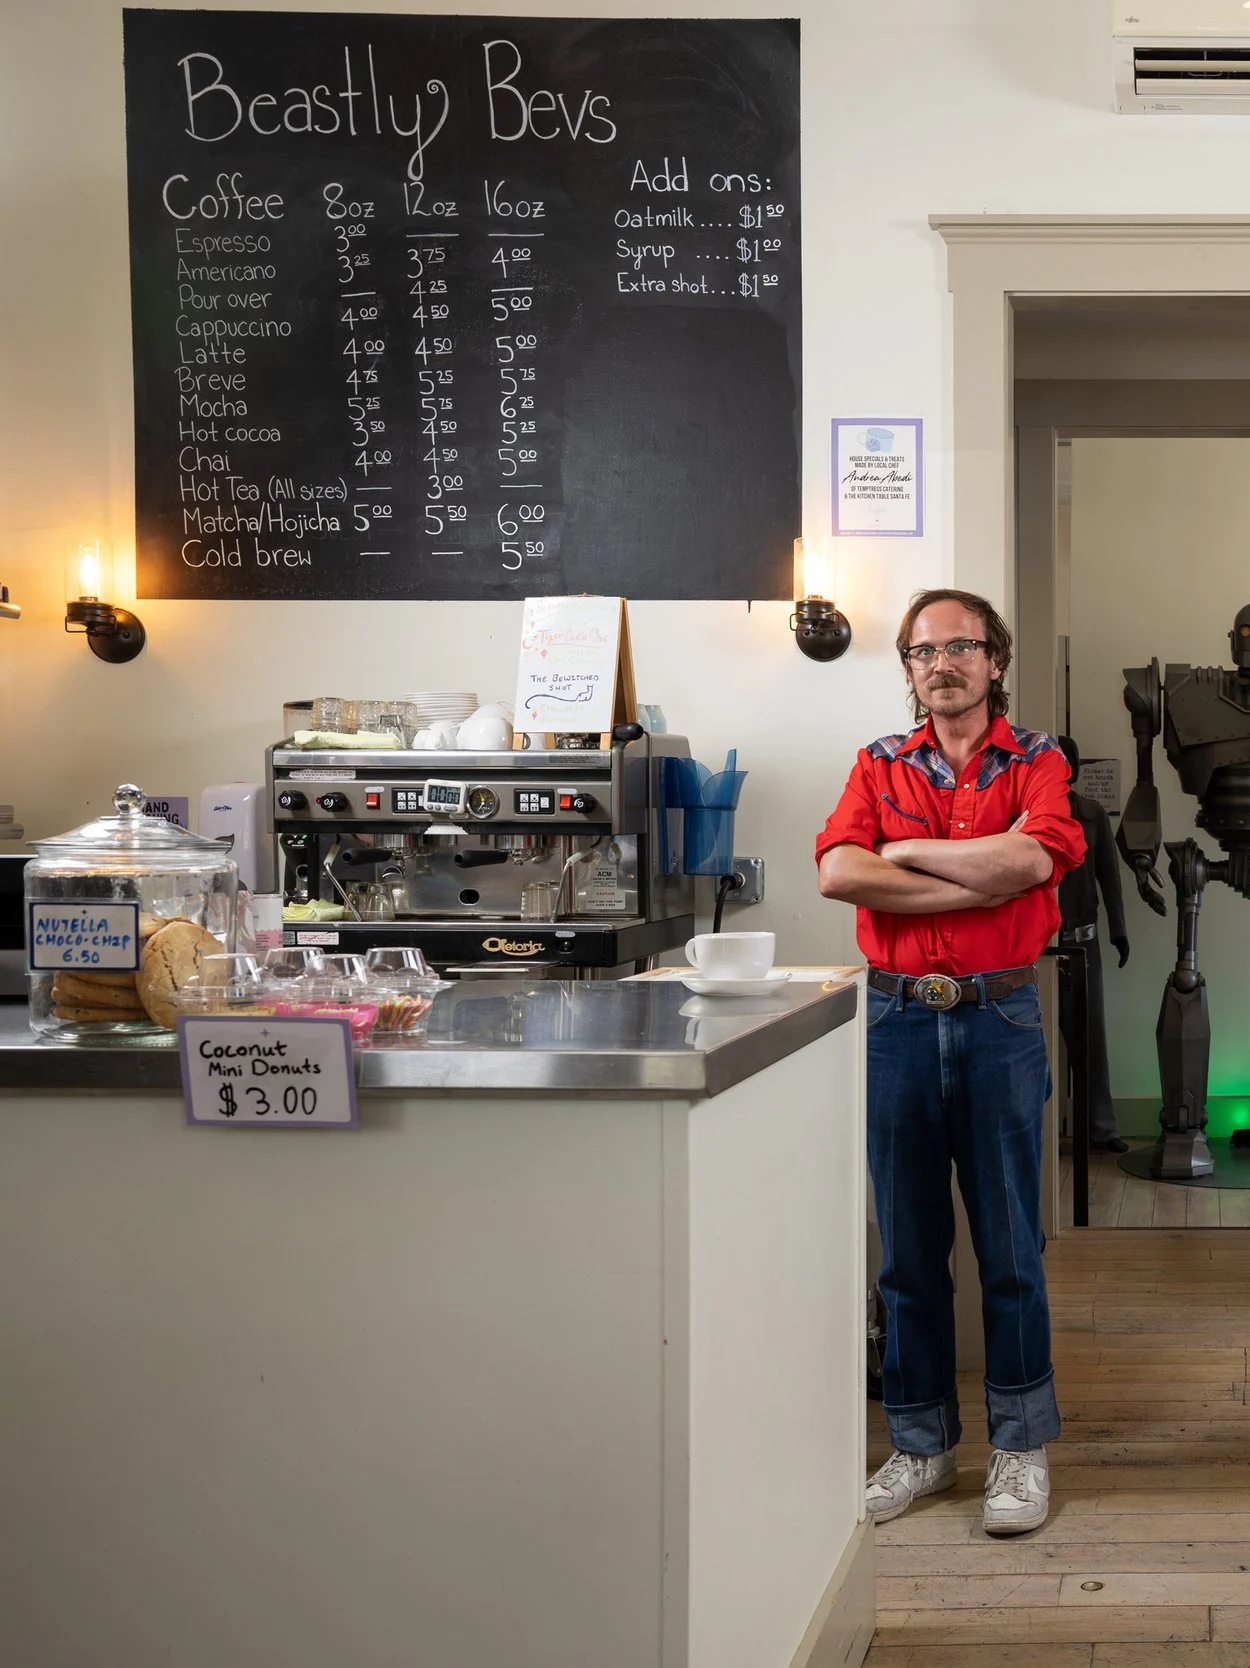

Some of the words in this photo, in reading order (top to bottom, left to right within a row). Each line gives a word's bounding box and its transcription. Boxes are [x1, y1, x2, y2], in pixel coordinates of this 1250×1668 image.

[178, 43, 449, 181] Beastly
[483, 40, 617, 143] Bevs
[630, 156, 689, 192] Add
[709, 172, 772, 193] ons:
[163, 172, 285, 220] Coffee
[323, 182, 375, 219] 8oz
[404, 181, 460, 217] 12oz
[484, 180, 546, 218] 16oz
[175, 228, 271, 260] Espresso
[616, 239, 675, 270] Syrup
[177, 258, 276, 281] Americano
[617, 272, 666, 293] Extra
[179, 284, 222, 310] Pour
[227, 293, 272, 308] over
[176, 315, 292, 346] Cappuccino
[180, 341, 246, 364] Latte
[174, 367, 246, 392] Breve
[180, 394, 248, 418] Mocha
[179, 421, 219, 441] Hot
[225, 427, 281, 441] cocoa
[179, 446, 231, 472] Chai
[180, 475, 219, 501] Hot
[225, 476, 259, 500] Tea
[842, 470, 881, 484] Andrea
[183, 501, 341, 538] Matcha/Hojicha
[181, 539, 242, 567] Cold
[255, 537, 311, 566] brew
[531, 674, 547, 683] THE
[552, 674, 600, 682] BEWITCHED
[36, 917, 109, 933] NUTELLA
[35, 934, 131, 950] CHOCO-CHIP
[62, 948, 100, 964] 6.50
[199, 1039, 288, 1059] Coconut
[207, 1061, 243, 1077] Mini
[251, 1057, 322, 1077] Donuts
